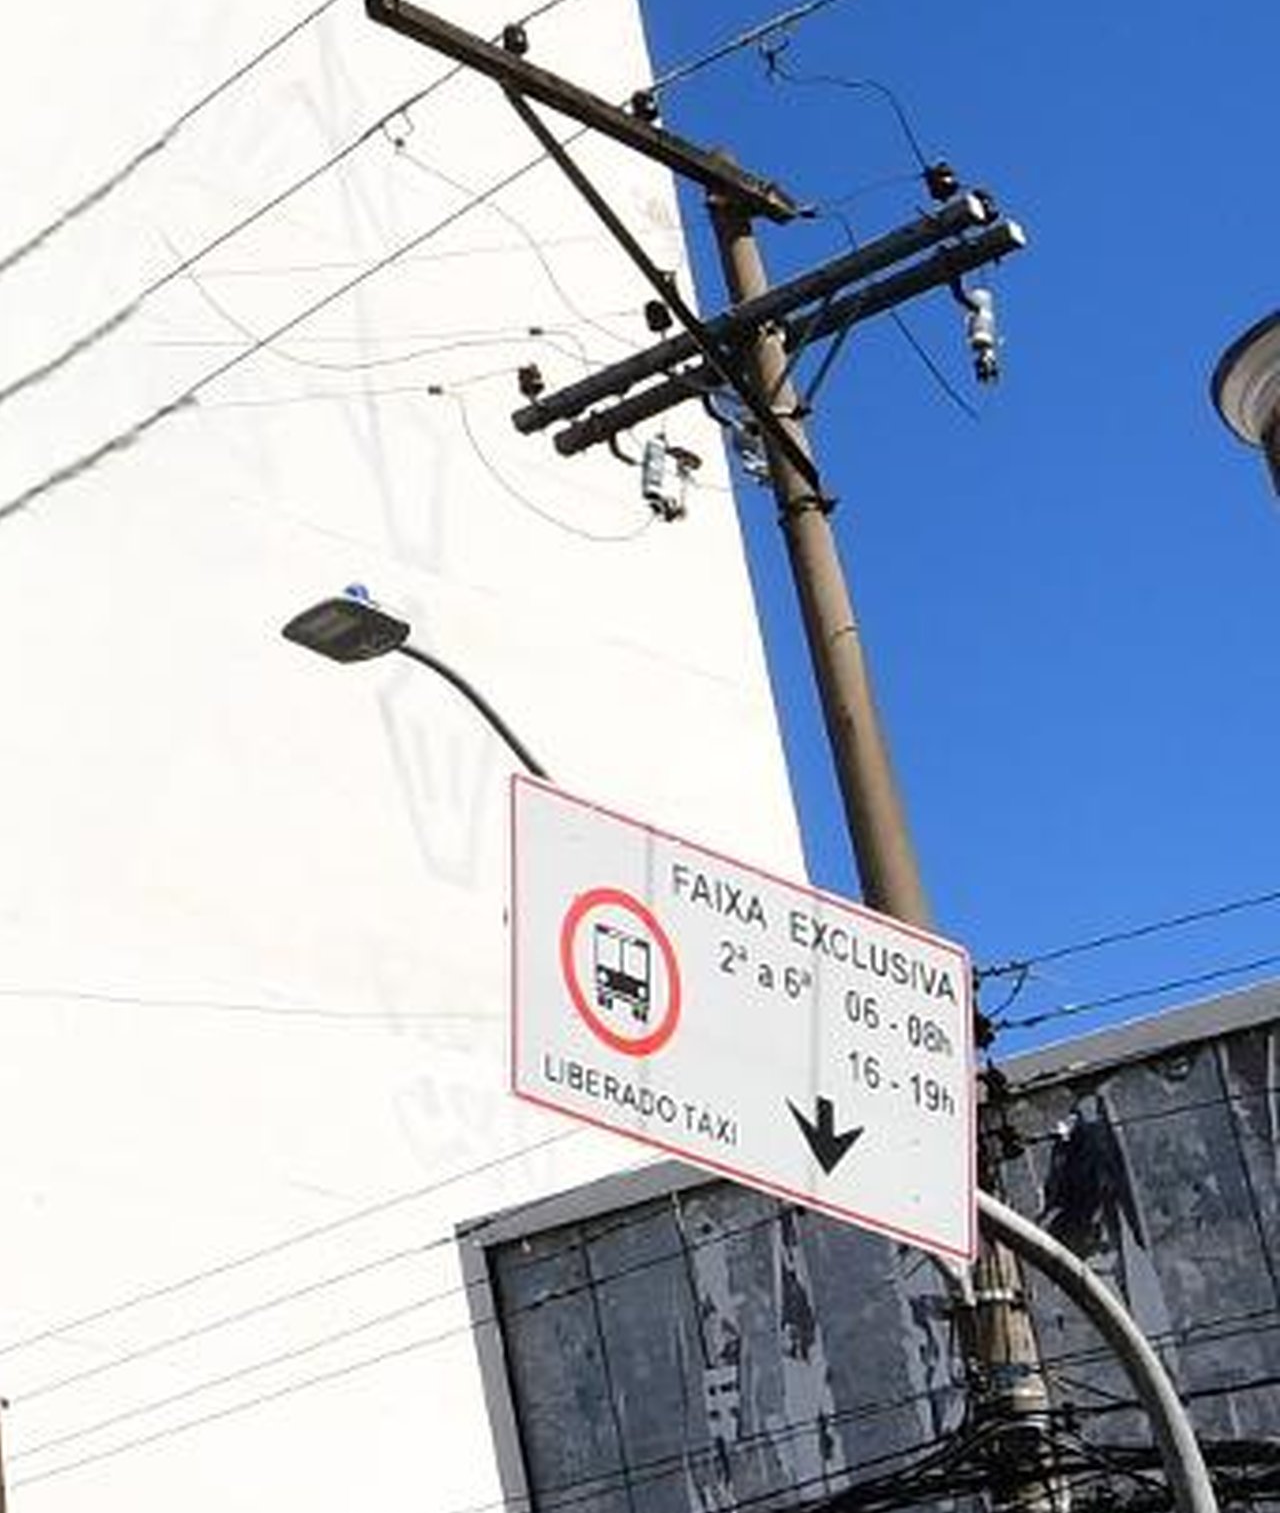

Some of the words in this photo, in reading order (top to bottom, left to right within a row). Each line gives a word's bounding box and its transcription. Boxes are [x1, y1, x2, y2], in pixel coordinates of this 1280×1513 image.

[671, 864, 769, 930] FAIXA
[789, 910, 958, 1005] EXCLUSIVA
[757, 965, 775, 989] a
[845, 989, 880, 1029] 06
[907, 1014, 954, 1057] 08h
[543, 1054, 677, 1124] LIBERADO
[684, 1106, 738, 1147] TAXI
[848, 1050, 881, 1089] 16
[909, 1072, 955, 1116] 19h
